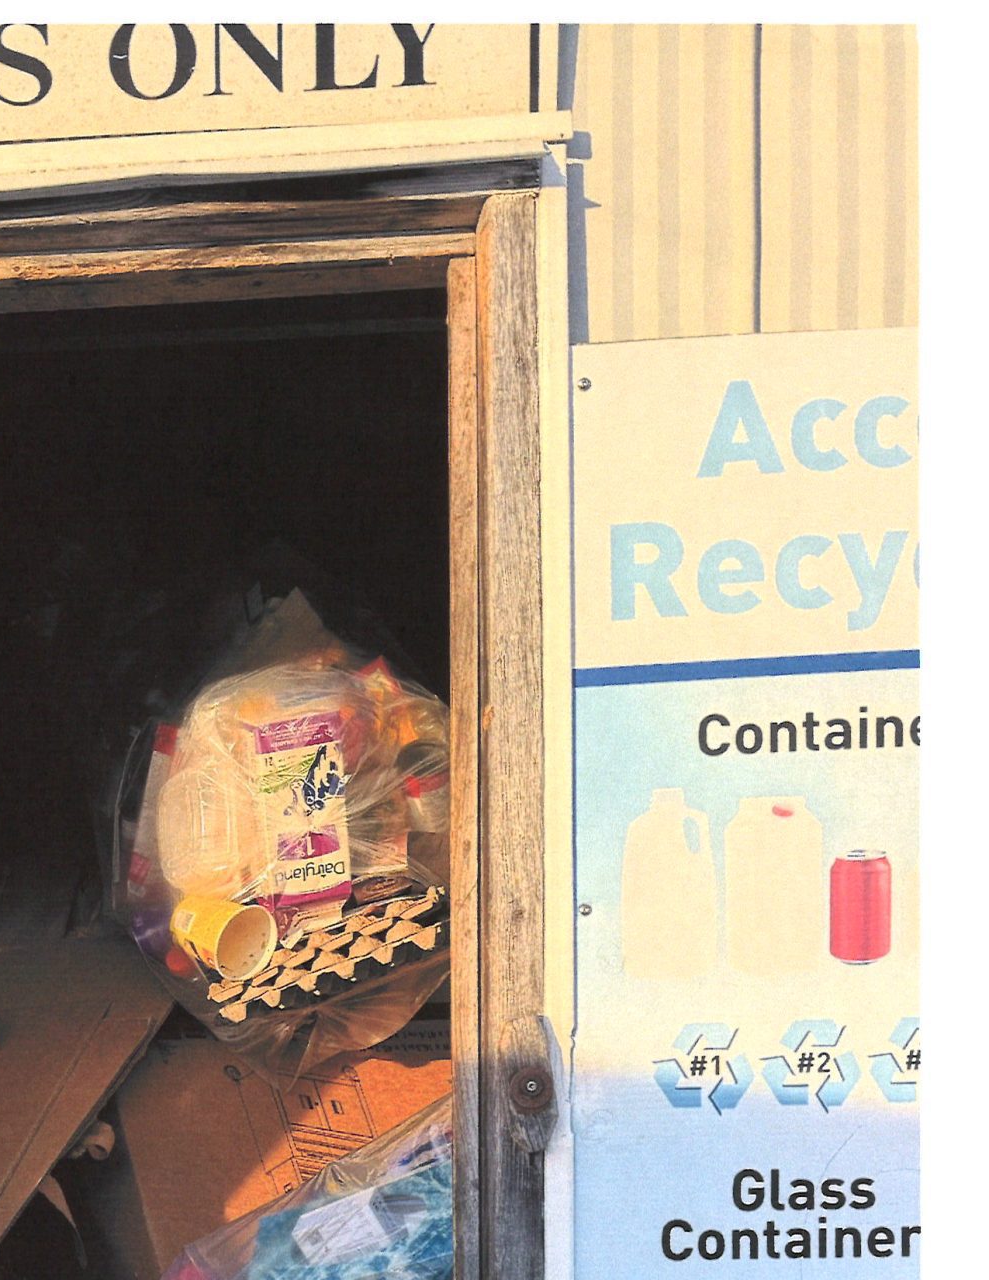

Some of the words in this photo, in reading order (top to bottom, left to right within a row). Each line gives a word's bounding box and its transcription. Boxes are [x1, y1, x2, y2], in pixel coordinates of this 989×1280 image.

[108, 24, 446, 101] ONLY
[696, 380, 920, 478] Acc
[610, 522, 920, 631] Recy
[274, 861, 345, 887] Dairyland
[690, 1055, 721, 1076] #1
[798, 1052, 831, 1073] #2
[732, 1168, 876, 1211] Glass
